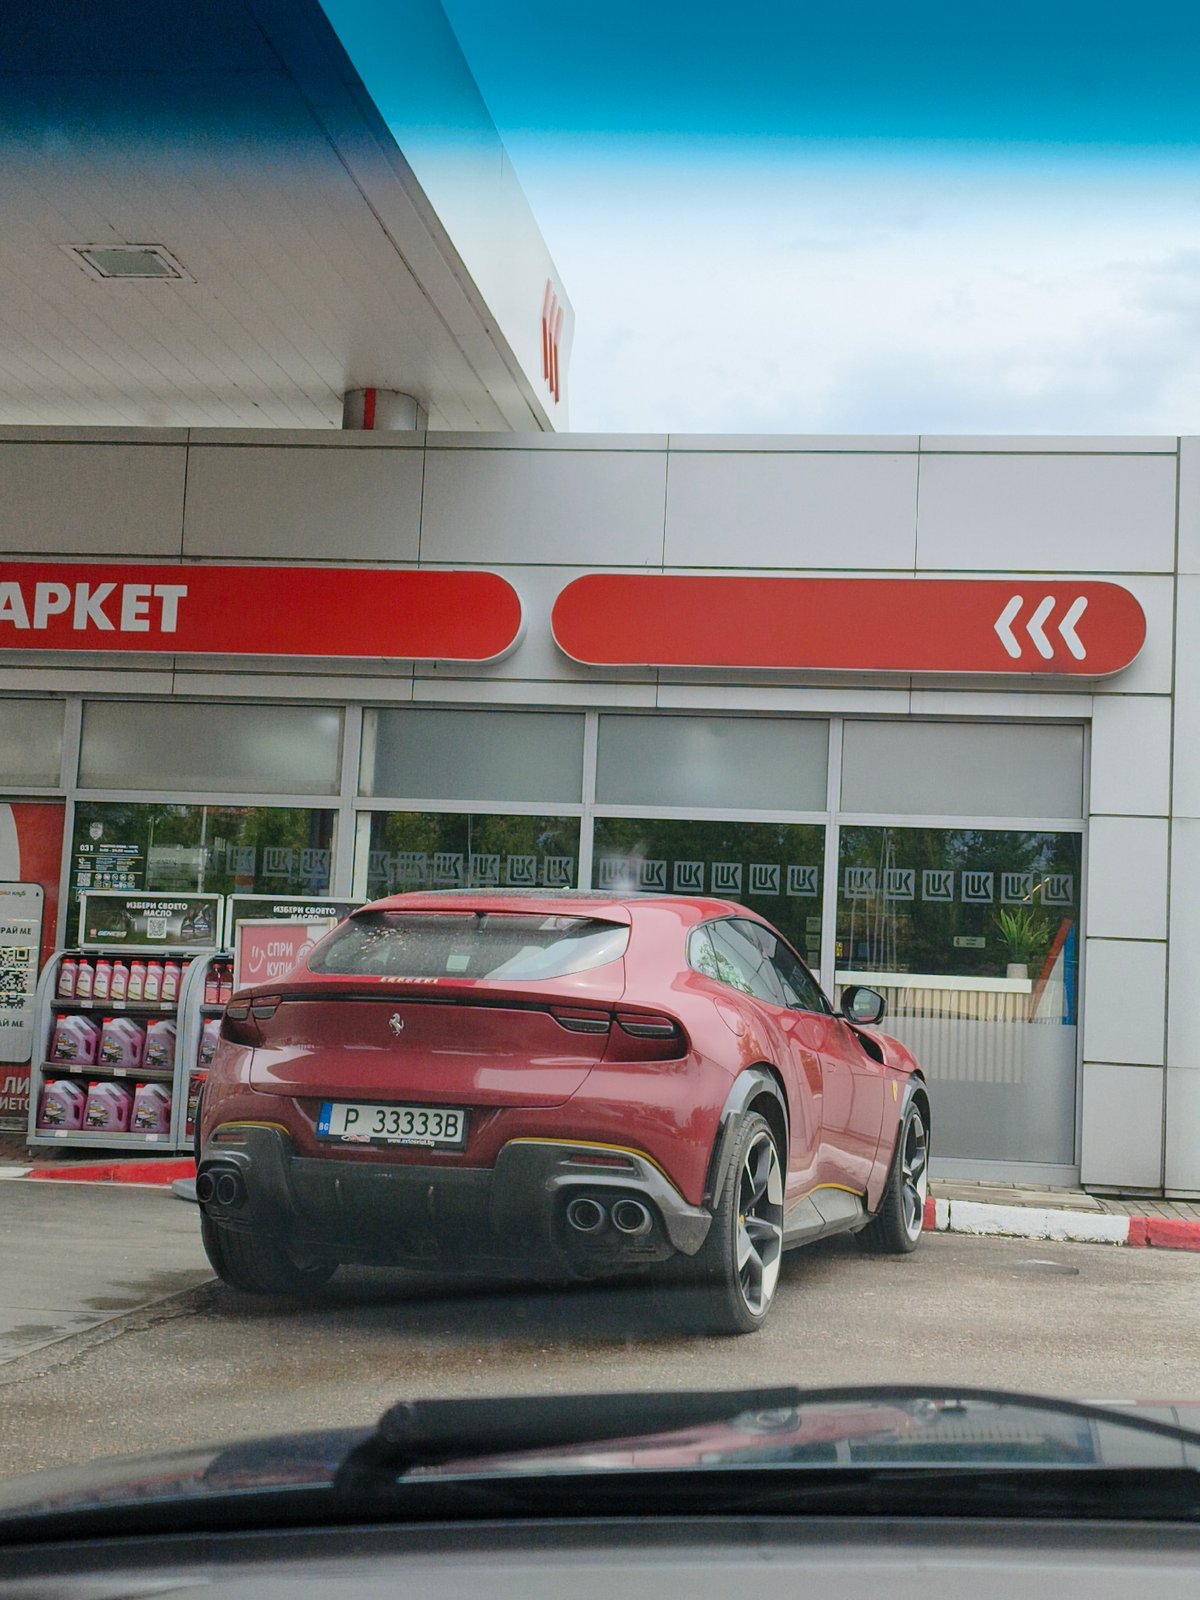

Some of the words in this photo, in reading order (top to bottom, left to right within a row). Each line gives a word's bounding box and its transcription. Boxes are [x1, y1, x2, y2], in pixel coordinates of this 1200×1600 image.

[126, 901, 156, 910] ИЗБЕРИ
[157, 902, 188, 910] СВОЕТО
[273, 905, 304, 913] ИЗБЕРИ
[143, 909, 172, 917] МАСЛО
[267, 942, 293, 956] СПРИ
[266, 961, 293, 976] КУПИ
[318, 1122, 329, 1131] BG
[372, 1110, 458, 1138] 33333B
